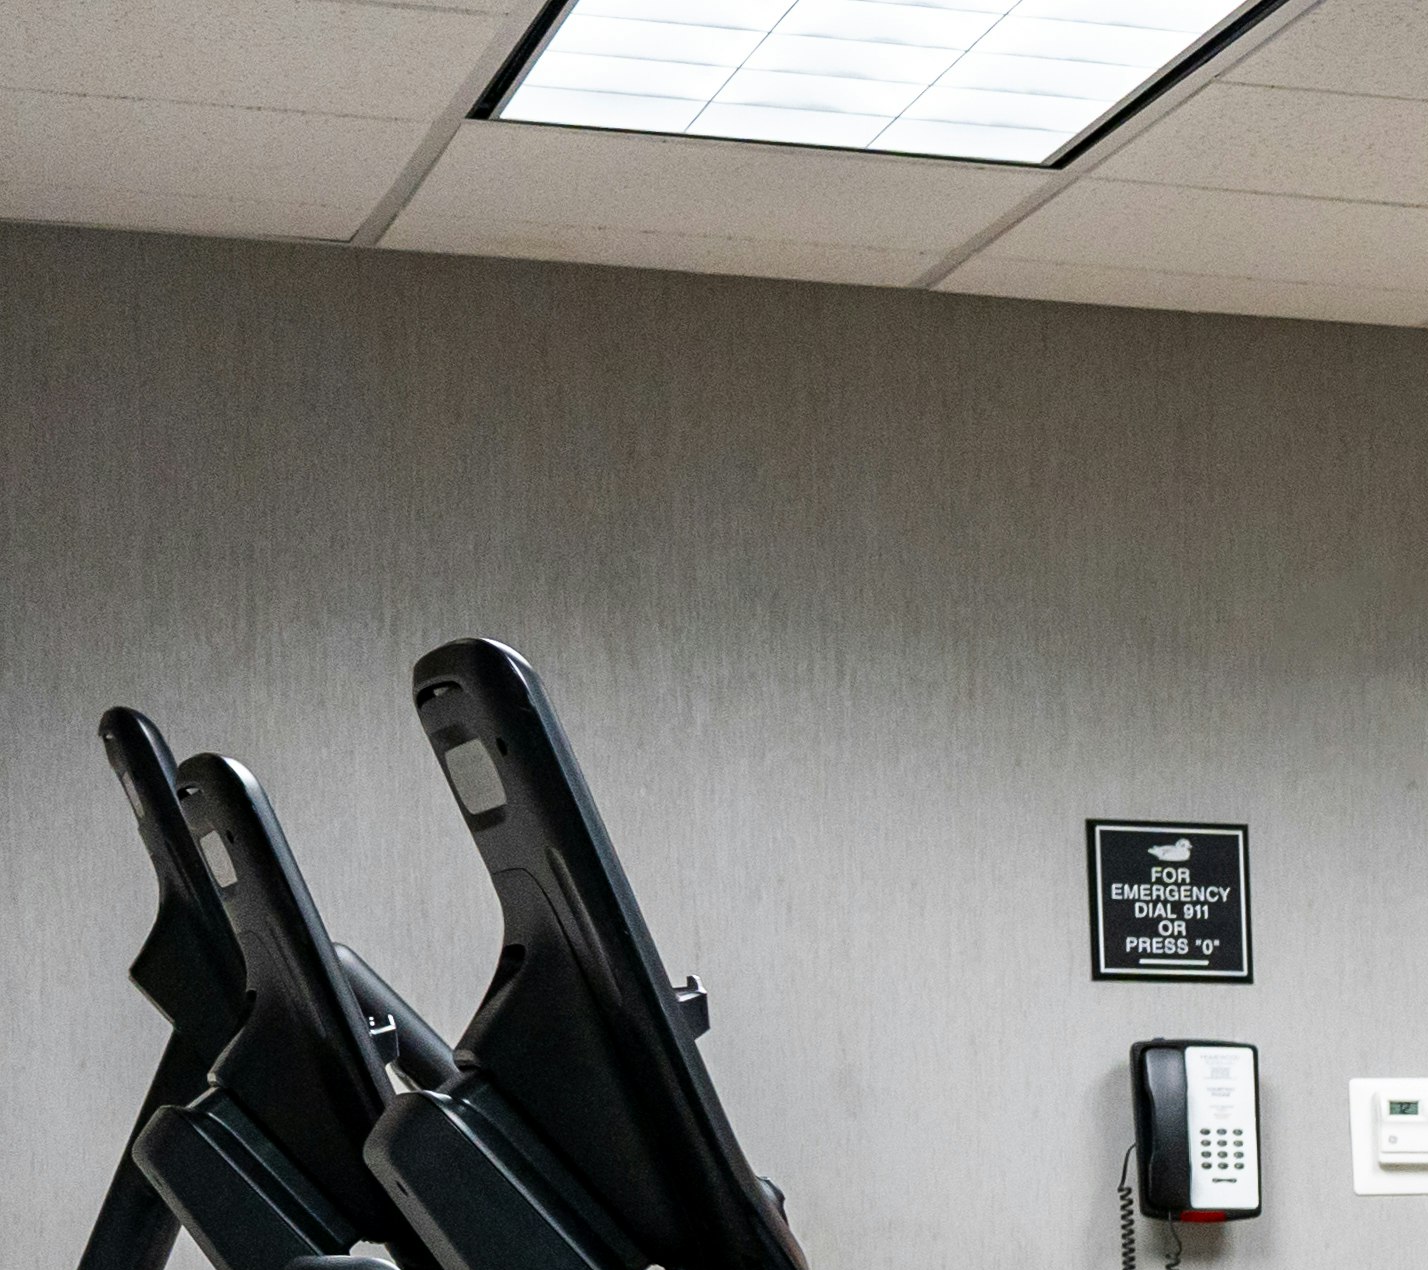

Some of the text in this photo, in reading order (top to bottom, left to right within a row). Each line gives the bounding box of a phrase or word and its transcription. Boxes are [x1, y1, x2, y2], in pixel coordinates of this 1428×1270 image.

[1151, 868, 1190, 883] FOR
[1111, 884, 1231, 902] EMERGENCY
[1135, 903, 1209, 920] DIAL 911
[1158, 921, 1187, 936] OR
[1126, 937, 1189, 954] PRESS
